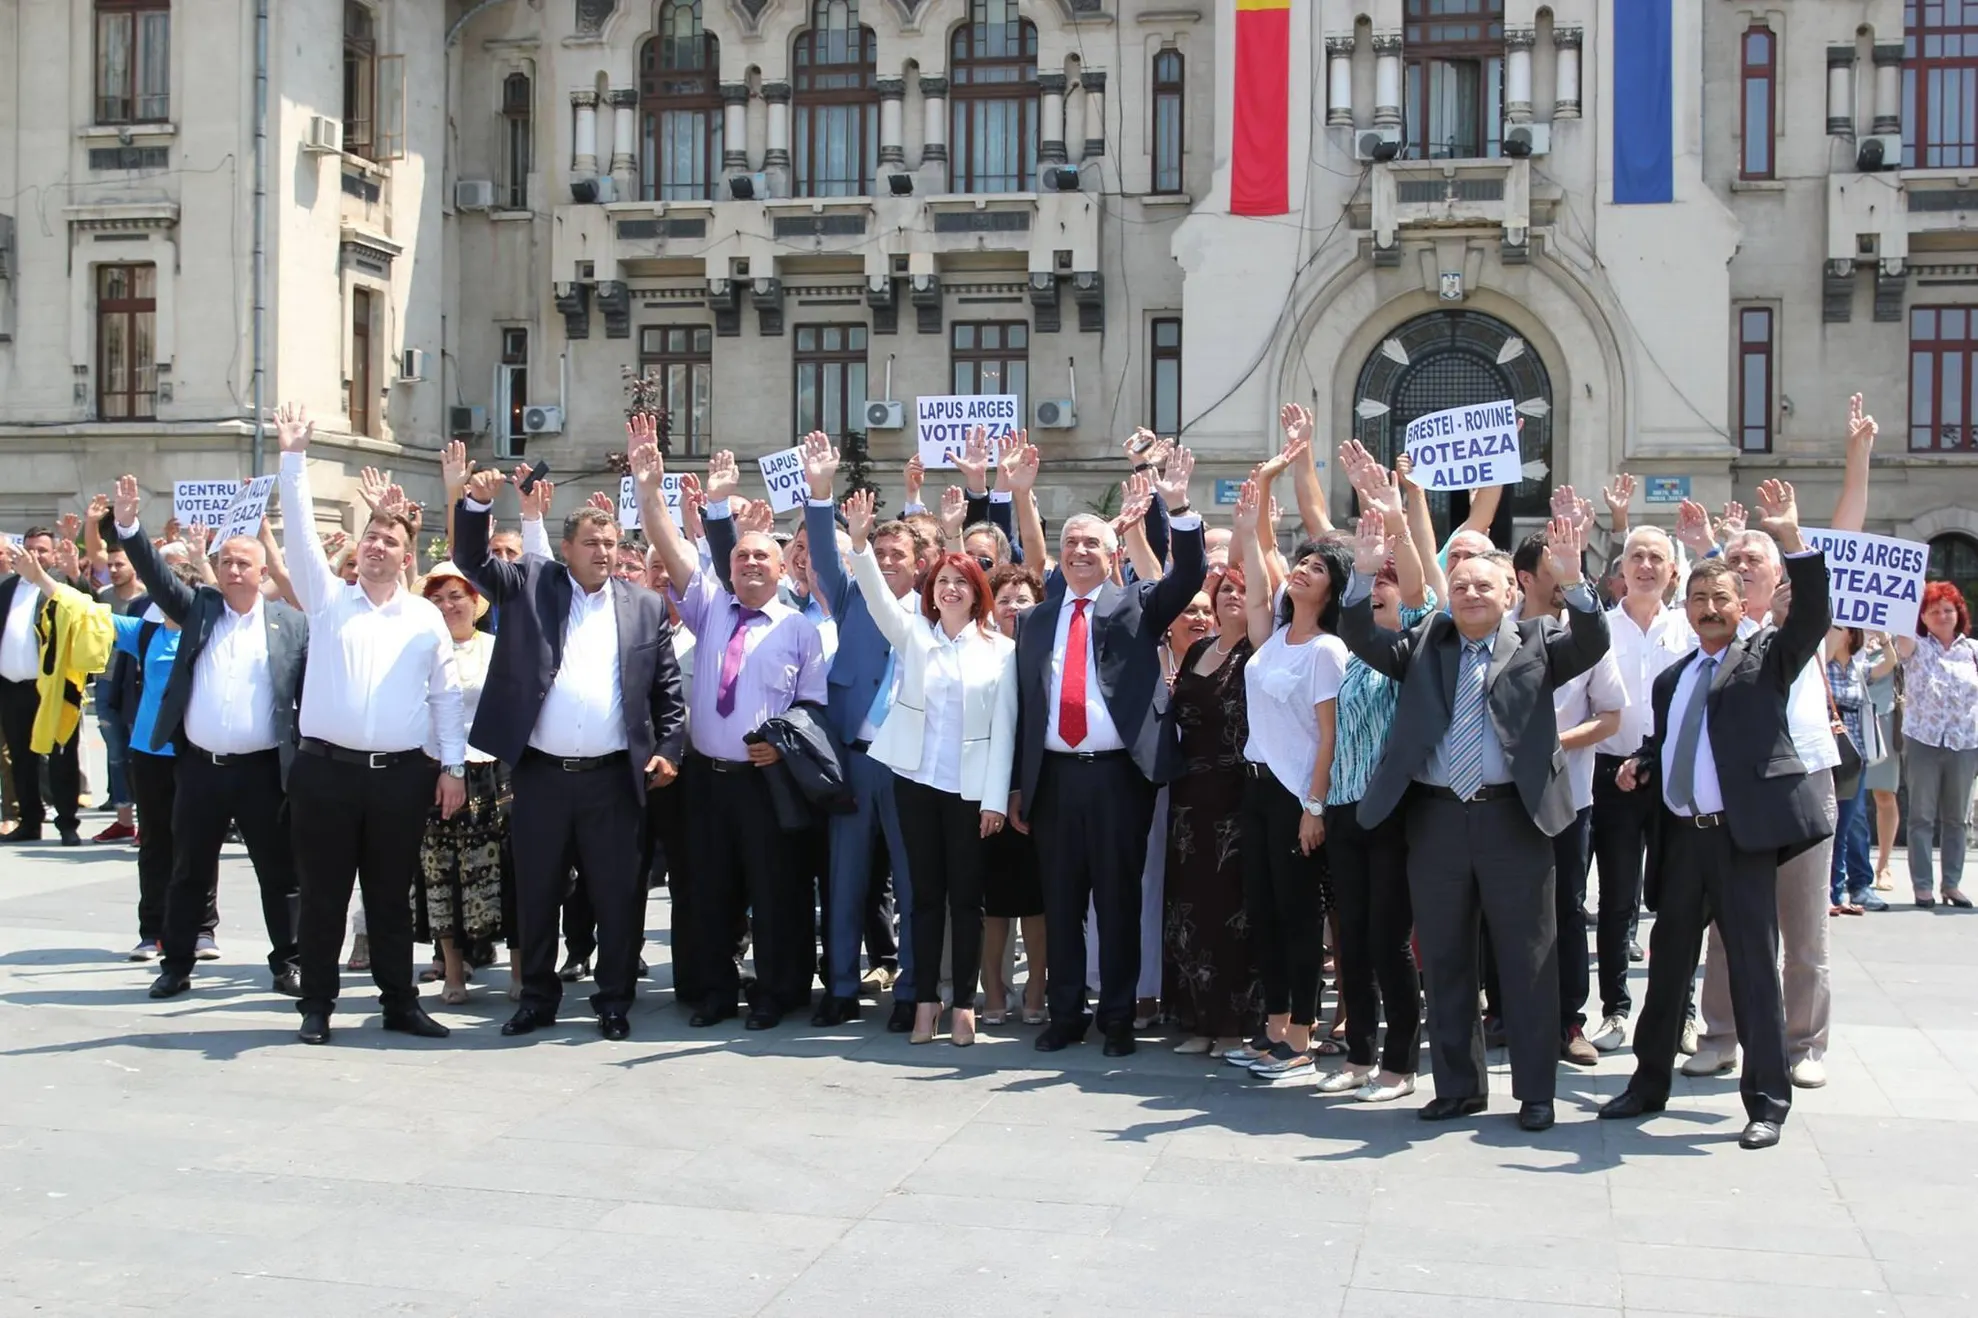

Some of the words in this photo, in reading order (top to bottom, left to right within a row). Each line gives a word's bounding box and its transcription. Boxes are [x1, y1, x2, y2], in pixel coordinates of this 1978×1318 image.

[920, 402, 963, 420] LAPUS
[968, 401, 1014, 418] ARGES
[921, 423, 1012, 442] VOTEZA
[1407, 415, 1454, 444] BRESTEI
[1464, 405, 1515, 431] ROVINE
[1407, 433, 1516, 467] VOTEAZA
[762, 453, 799, 476] LAPUS
[1432, 462, 1493, 487] ALDE
[178, 484, 237, 497] CENTRU
[176, 499, 229, 511] VOTEAZ
[1810, 536, 1857, 563] APUS
[1861, 542, 1924, 574] ARGES
[1832, 567, 1917, 603] TEAZA
[1829, 597, 1889, 626] LDE
